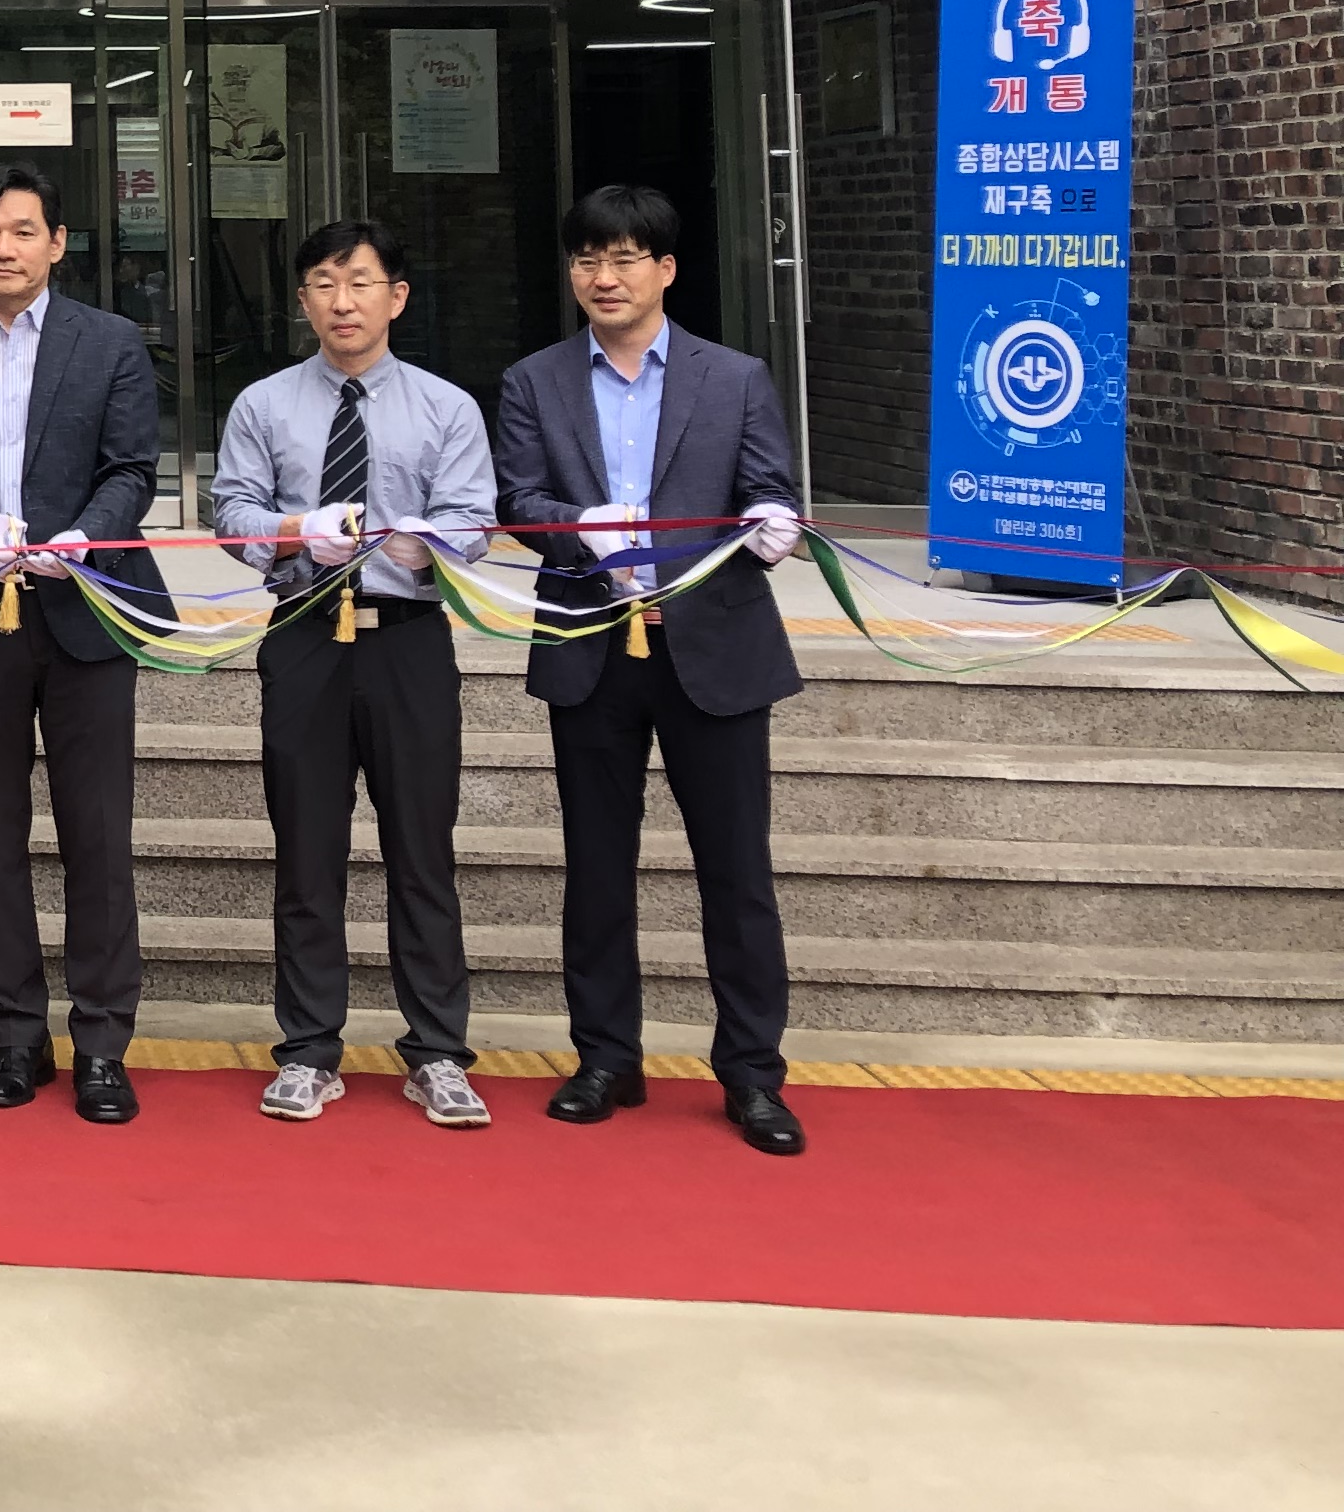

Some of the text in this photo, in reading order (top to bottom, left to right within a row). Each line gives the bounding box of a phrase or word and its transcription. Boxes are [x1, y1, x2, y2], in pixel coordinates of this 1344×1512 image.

[957, 140, 1120, 174] 종합상담시스템
[983, 184, 1097, 216] 재구축 으로
[942, 234, 1126, 269] 더 가까이 다가갑니다.
